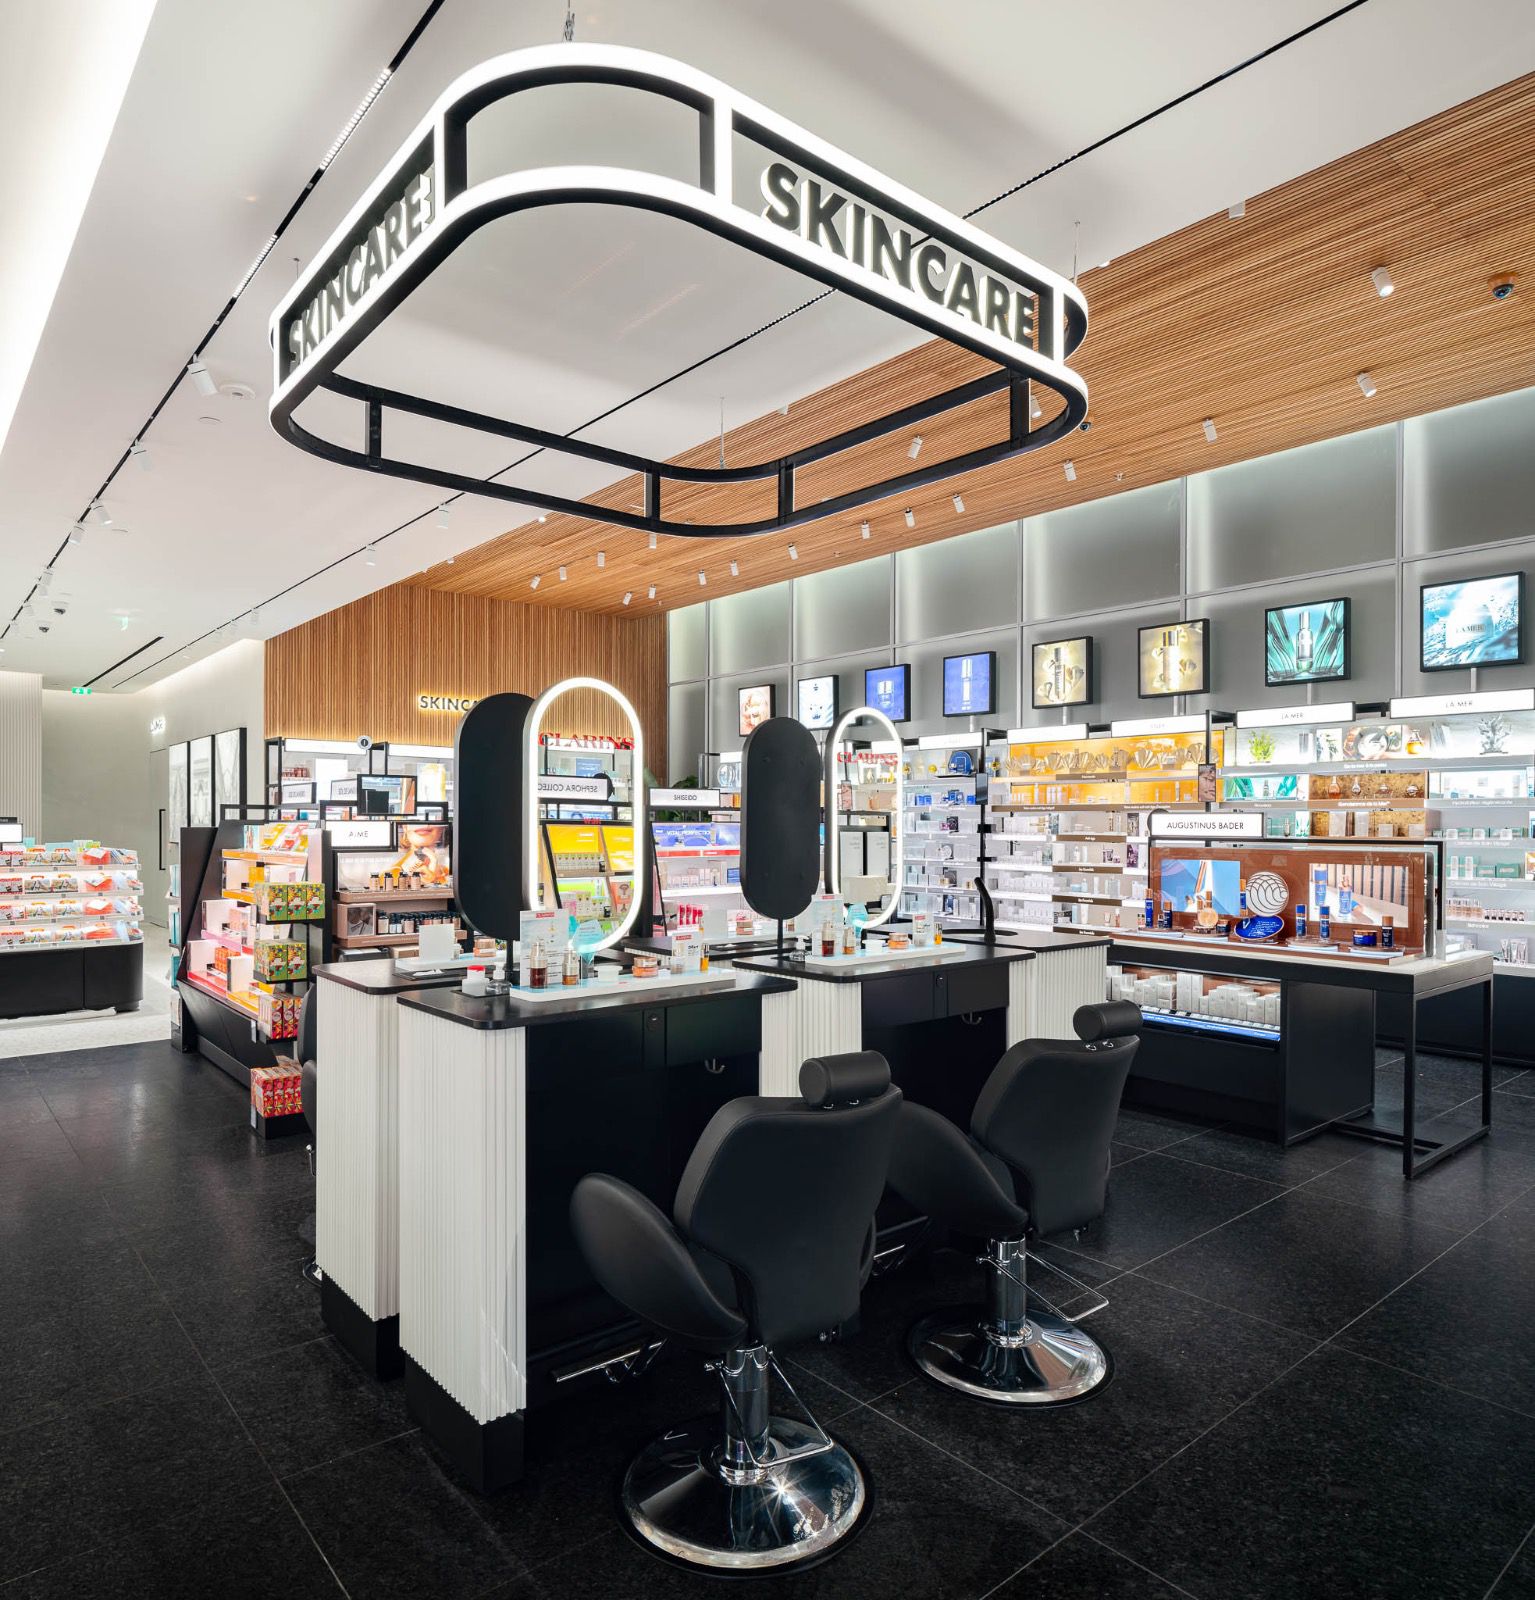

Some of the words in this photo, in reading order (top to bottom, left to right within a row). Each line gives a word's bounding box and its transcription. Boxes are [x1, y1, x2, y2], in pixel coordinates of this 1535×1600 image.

[289, 173, 431, 373] SKINCARE
[761, 162, 1035, 345] SKINCARE
[538, 732, 635, 750] CLARINS
[1166, 821, 1217, 830] AUGUSTINUS
[1218, 822, 1244, 830] BADER
